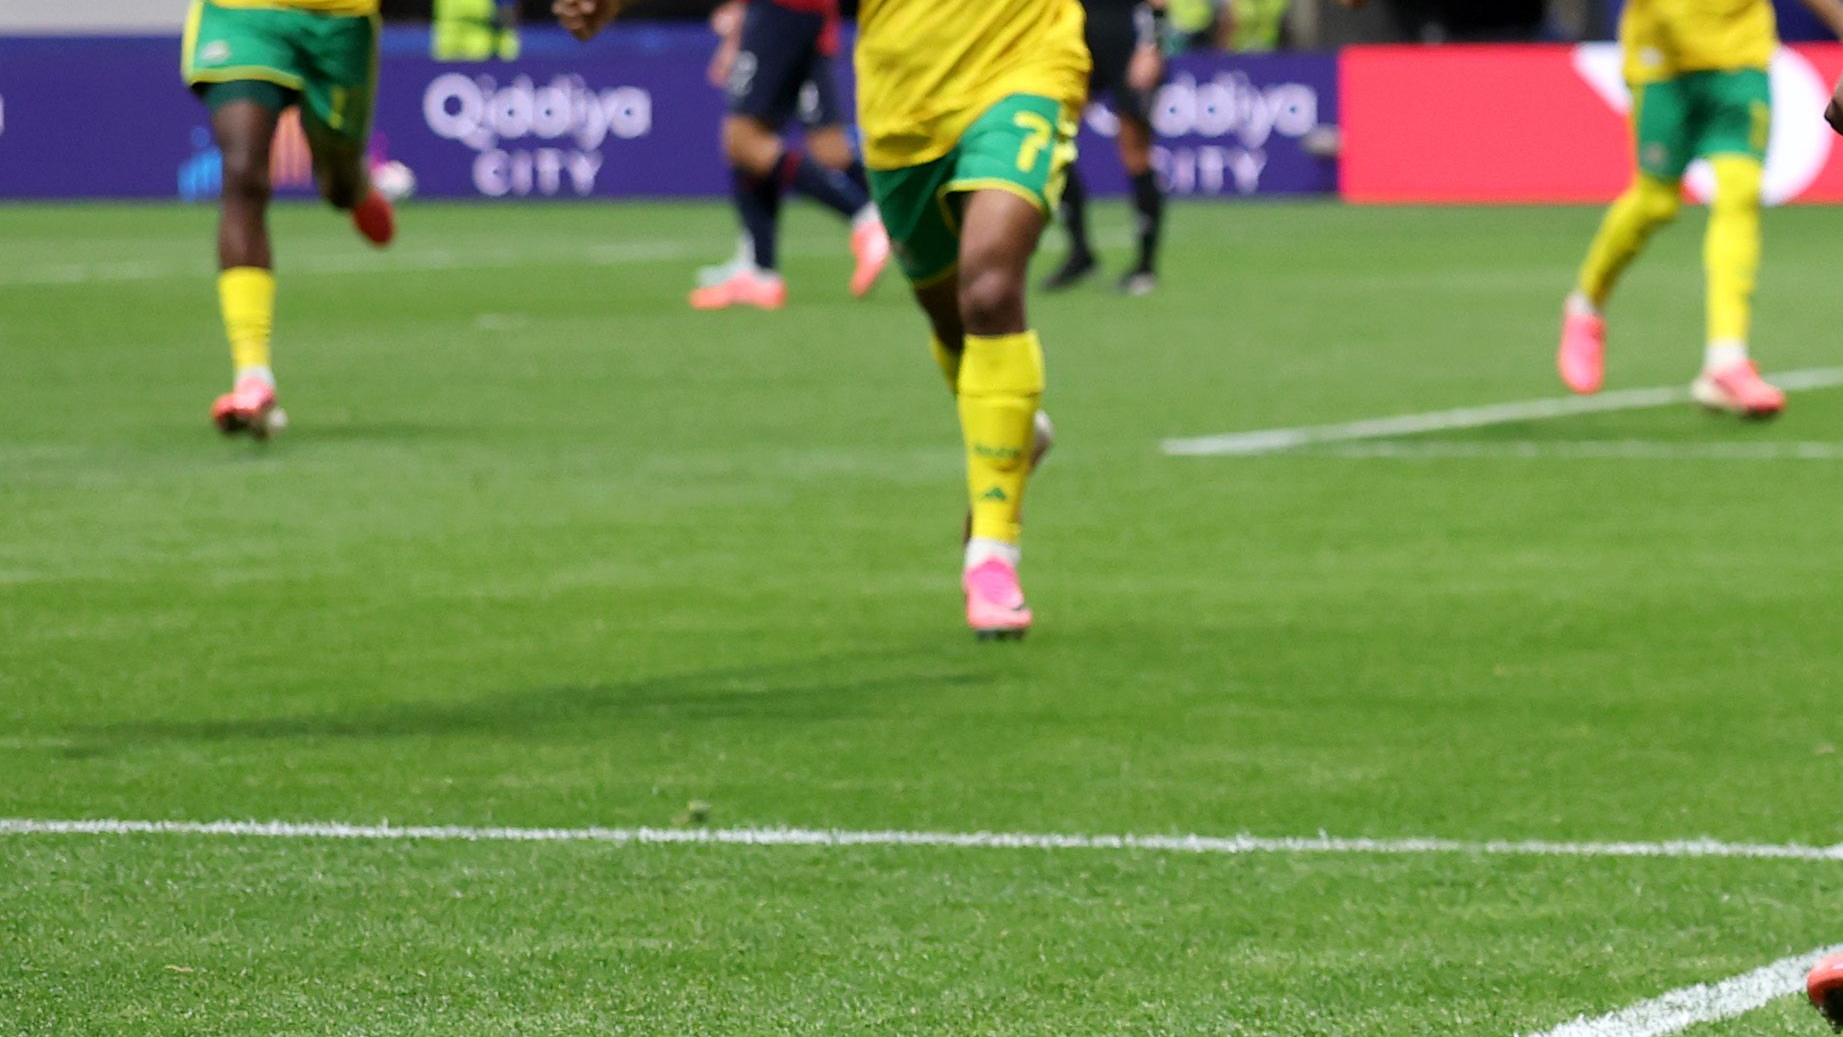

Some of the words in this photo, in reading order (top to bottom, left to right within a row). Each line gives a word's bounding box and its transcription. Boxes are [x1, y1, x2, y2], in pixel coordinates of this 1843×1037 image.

[423, 72, 653, 151] Qiddiya
[1014, 110, 1053, 173] 7
[1084, 71, 1318, 149] ddiya
[473, 149, 603, 197] CITY
